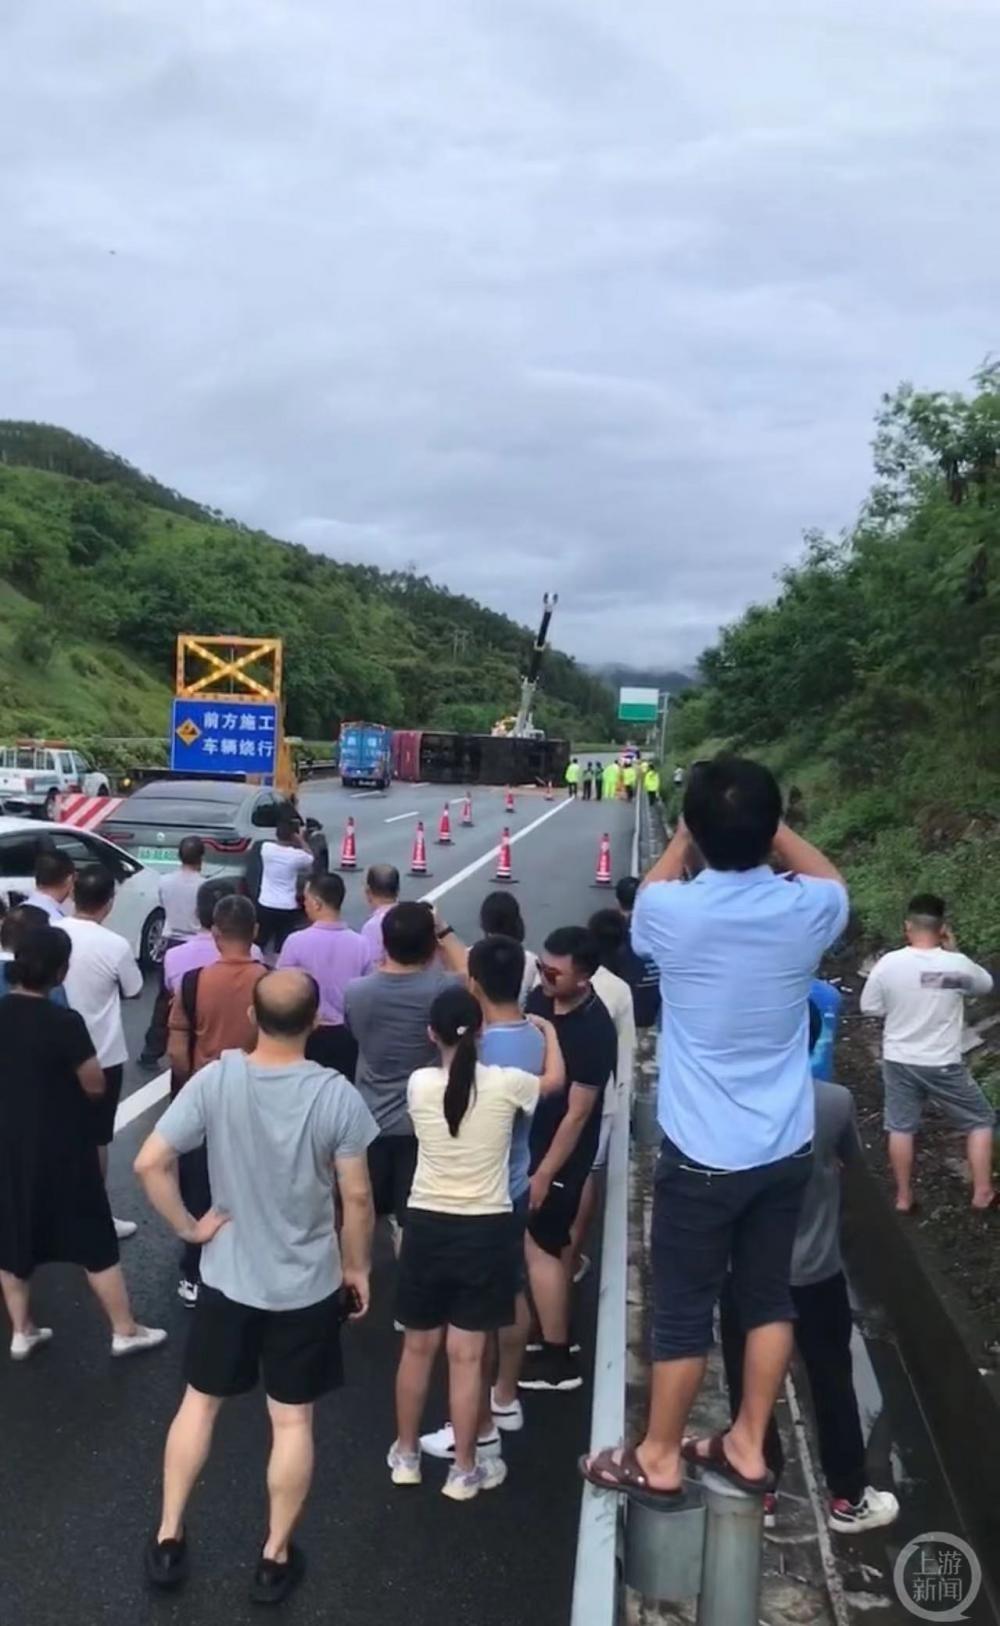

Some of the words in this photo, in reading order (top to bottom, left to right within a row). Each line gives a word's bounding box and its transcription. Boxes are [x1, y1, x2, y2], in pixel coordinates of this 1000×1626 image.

[203, 711, 274, 731] 前方施工
[202, 737, 274, 757] 车辆绕行
